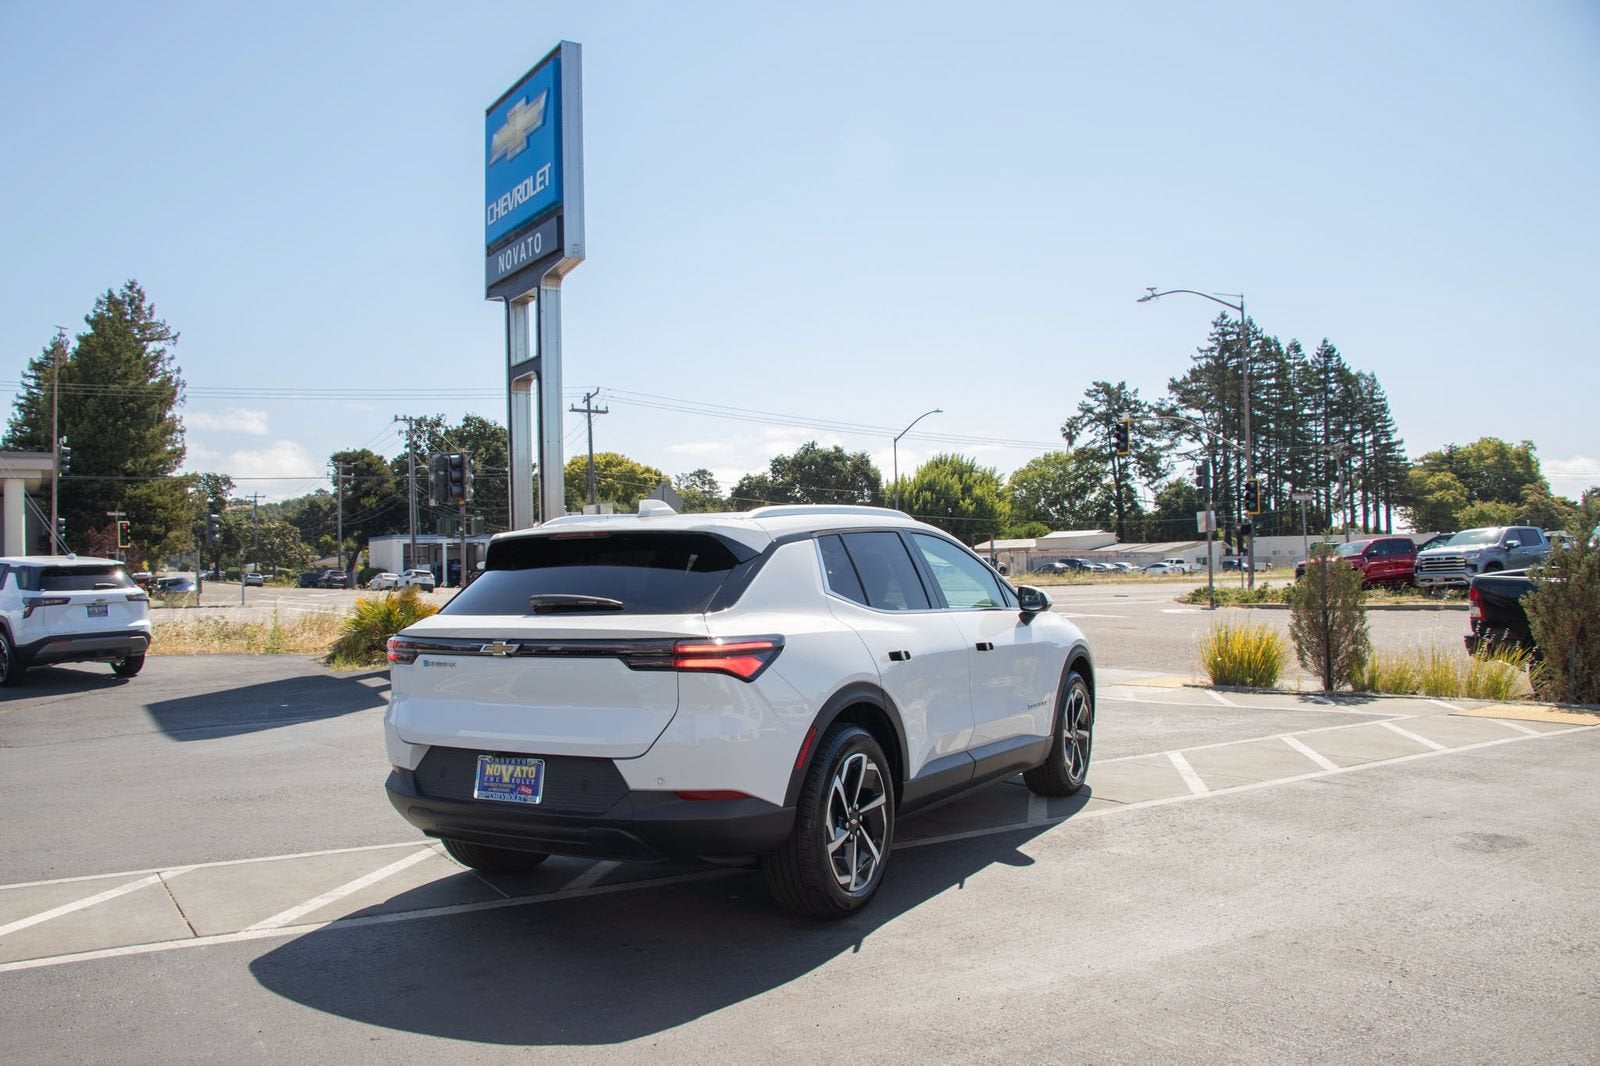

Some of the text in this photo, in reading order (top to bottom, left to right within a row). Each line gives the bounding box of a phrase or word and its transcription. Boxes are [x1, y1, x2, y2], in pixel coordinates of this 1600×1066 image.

[487, 162, 551, 226] CHEVROLET
[498, 232, 542, 275] NOVATO
[485, 764, 536, 782] NOVATO
